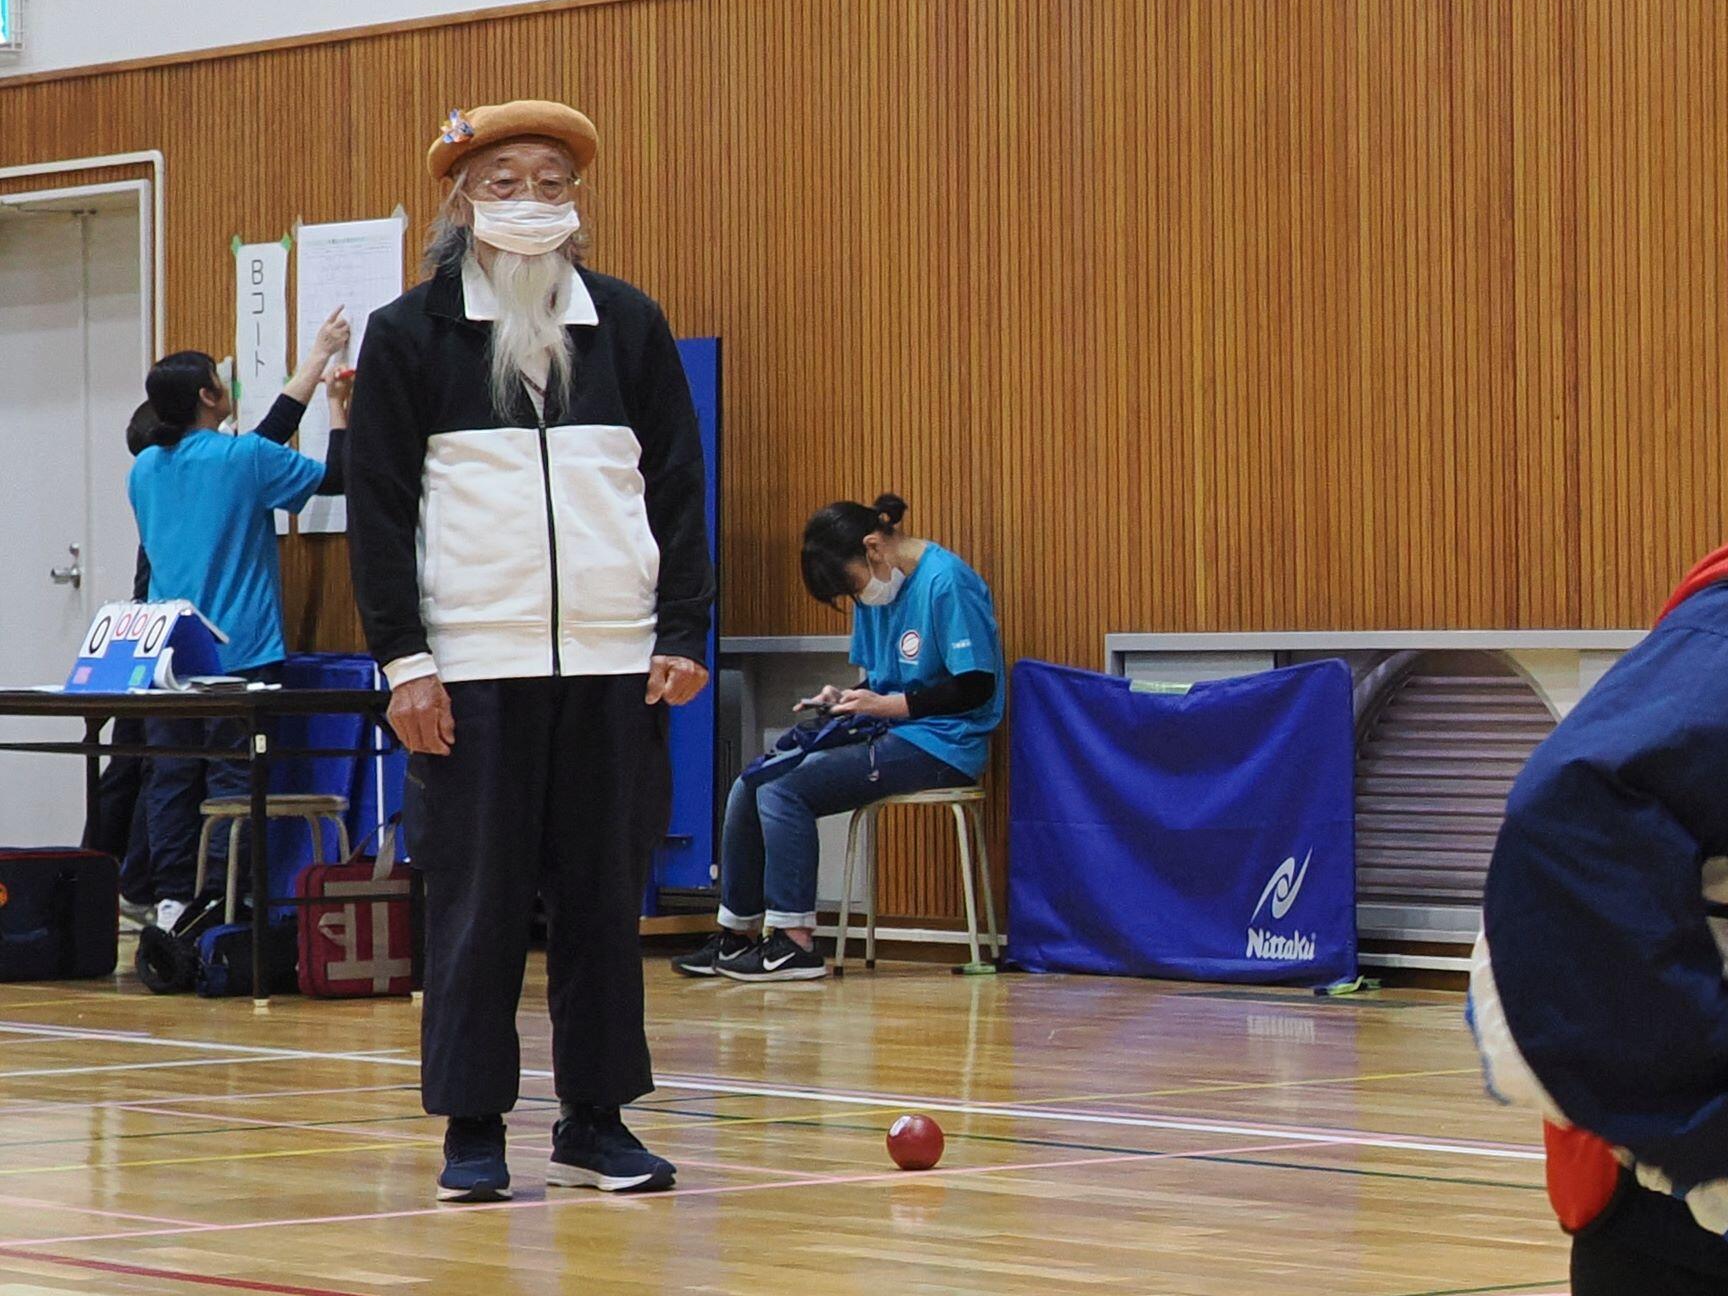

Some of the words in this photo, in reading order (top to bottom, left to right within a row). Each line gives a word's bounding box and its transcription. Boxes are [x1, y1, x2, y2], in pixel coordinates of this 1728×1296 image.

[251, 259, 266, 378] Bコート
[88, 615, 111, 655] 0
[115, 613, 132, 637] 0
[131, 613, 148, 636] 0
[143, 615, 167, 654] 0
[1246, 927, 1316, 961] Nittaku
